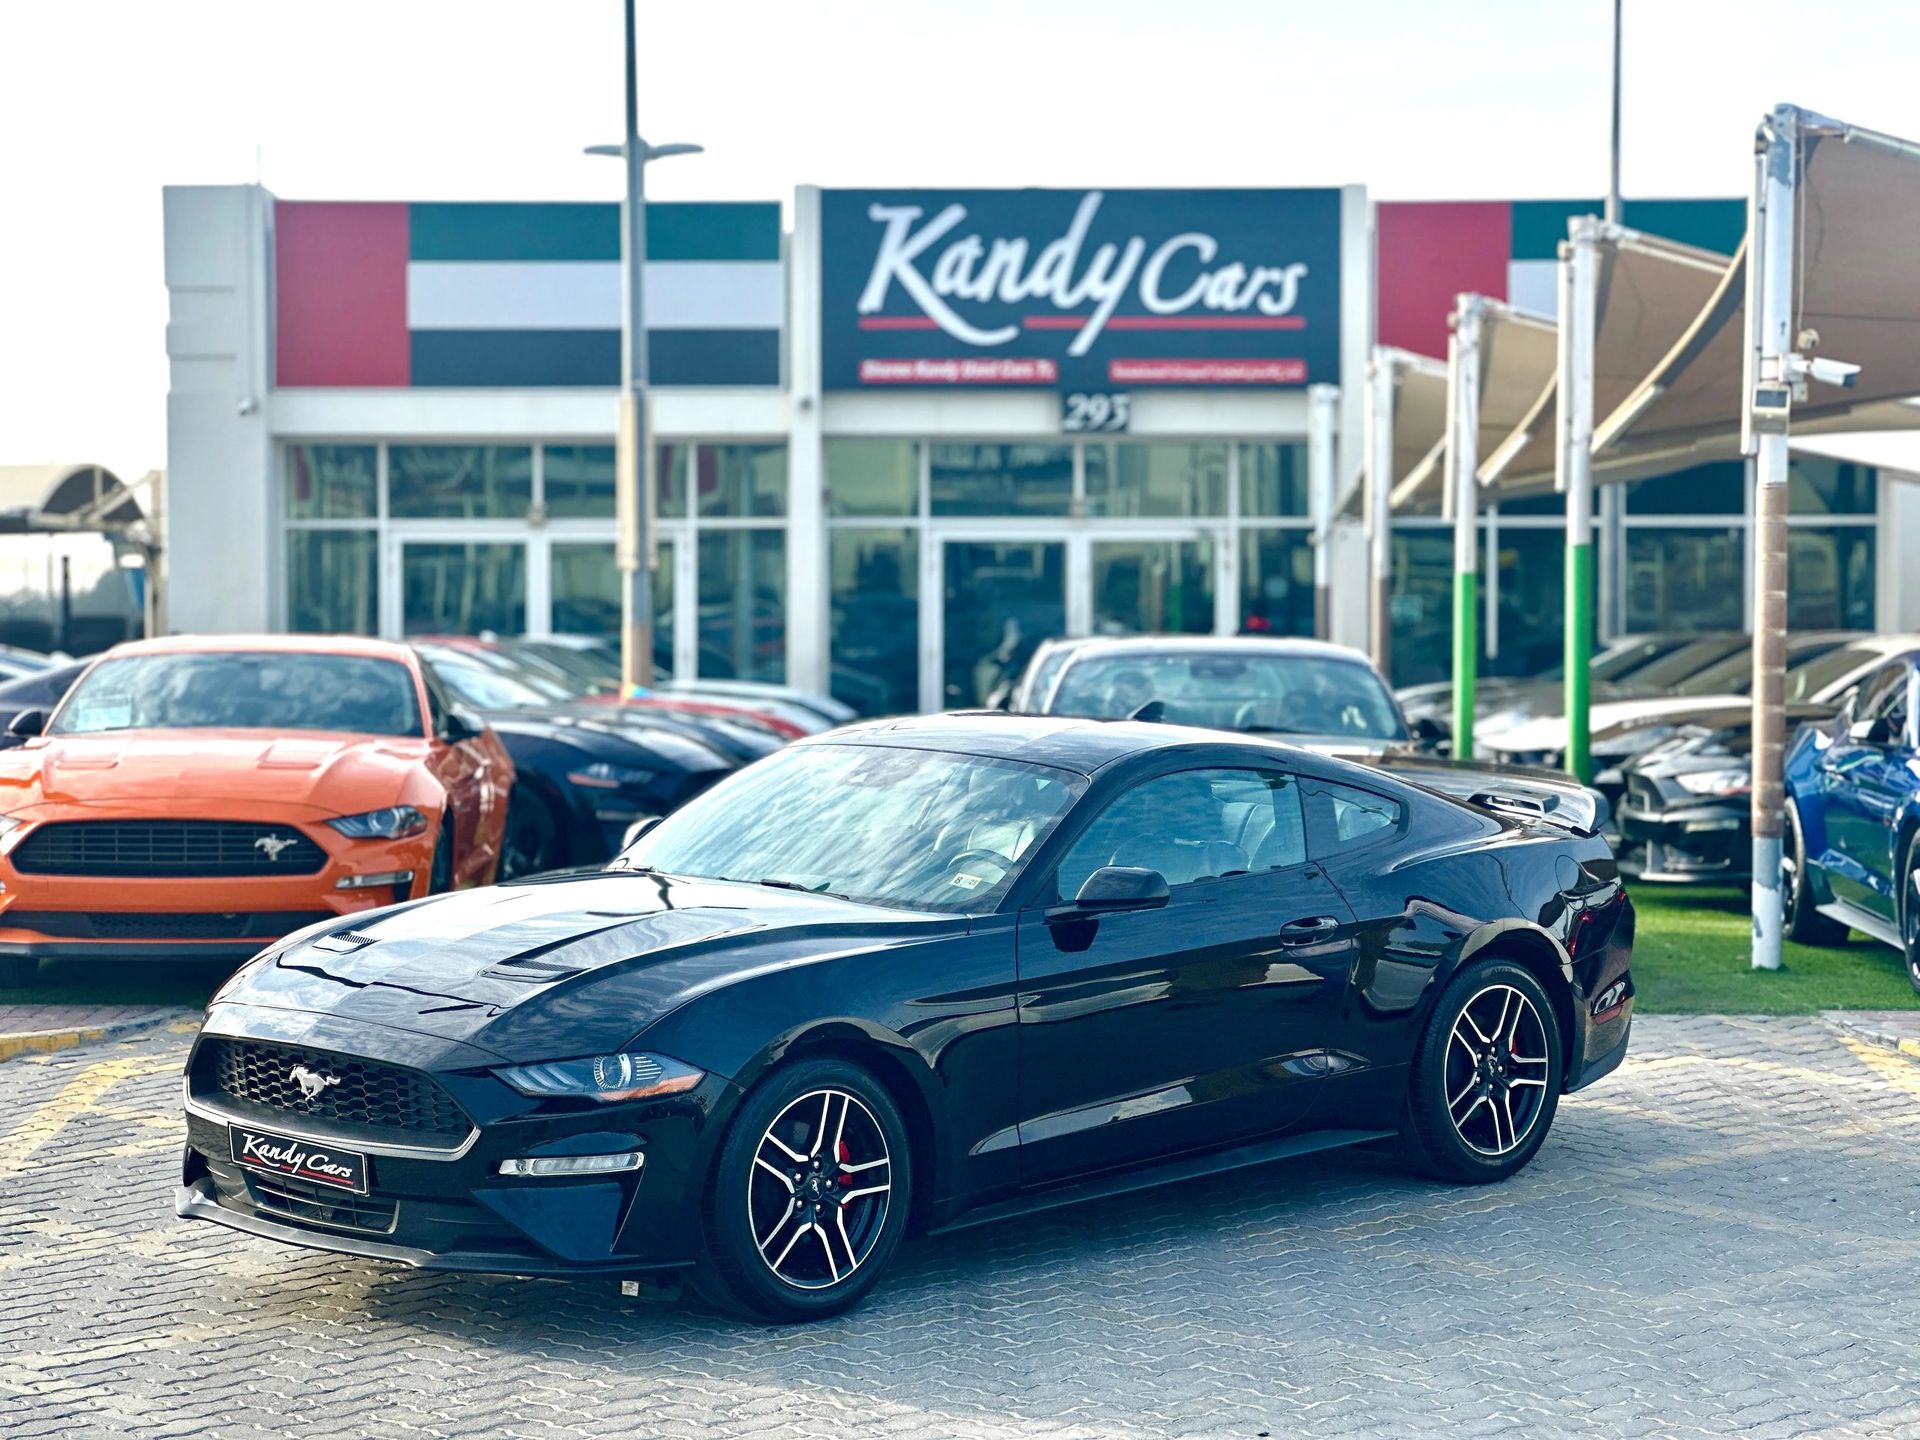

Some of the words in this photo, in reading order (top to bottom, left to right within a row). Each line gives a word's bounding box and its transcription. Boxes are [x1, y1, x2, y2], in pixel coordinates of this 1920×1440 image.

[857, 190, 1145, 356] Kandy
[1138, 232, 1308, 316] Cars
[242, 1133, 305, 1174] Kandy
[306, 1154, 353, 1178] Cars
